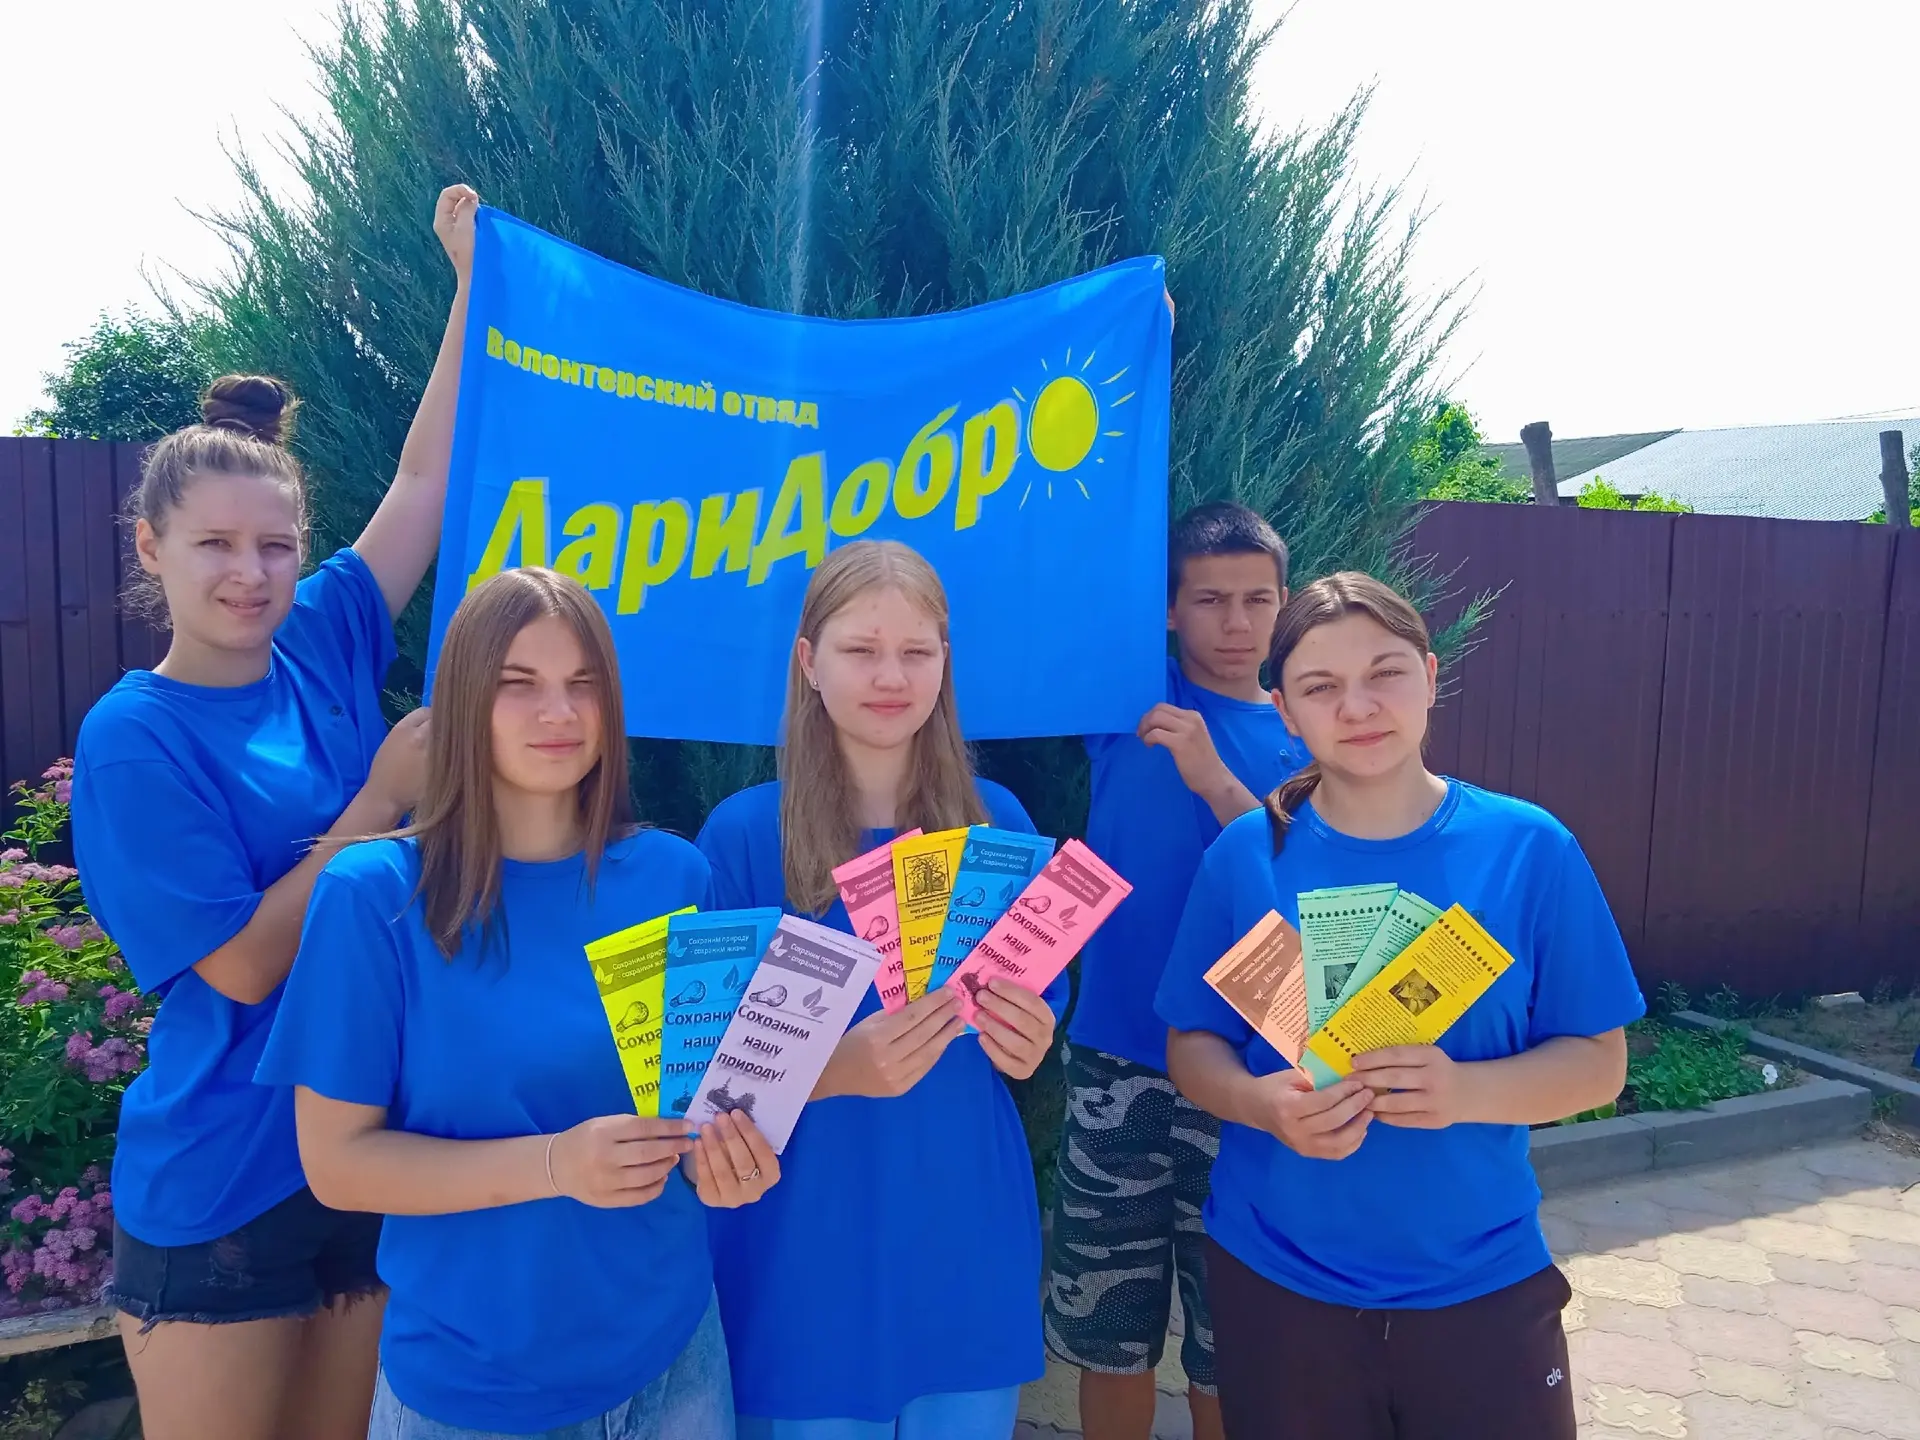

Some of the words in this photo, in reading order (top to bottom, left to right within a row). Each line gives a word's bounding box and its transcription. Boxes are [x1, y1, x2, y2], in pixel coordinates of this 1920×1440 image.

[486, 325, 717, 413] Волонтерский
[723, 388, 819, 430] отряд
[947, 910, 996, 929] Сохран
[1007, 906, 1057, 948] Сохраним
[688, 936, 720, 945] Сохраним
[790, 943, 820, 960] Сохраним
[1002, 933, 1032, 956] нашу
[613, 955, 646, 970] Сохраним
[646, 948, 666, 960] приро
[887, 960, 903, 974] на
[978, 942, 1028, 977] природу!
[665, 1010, 733, 1027] Сохрани
[738, 1004, 811, 1040] Сохраним
[617, 1028, 662, 1050] Сохра
[742, 1035, 784, 1057] нашу
[643, 1054, 661, 1068] на
[716, 1052, 787, 1082] природу!
